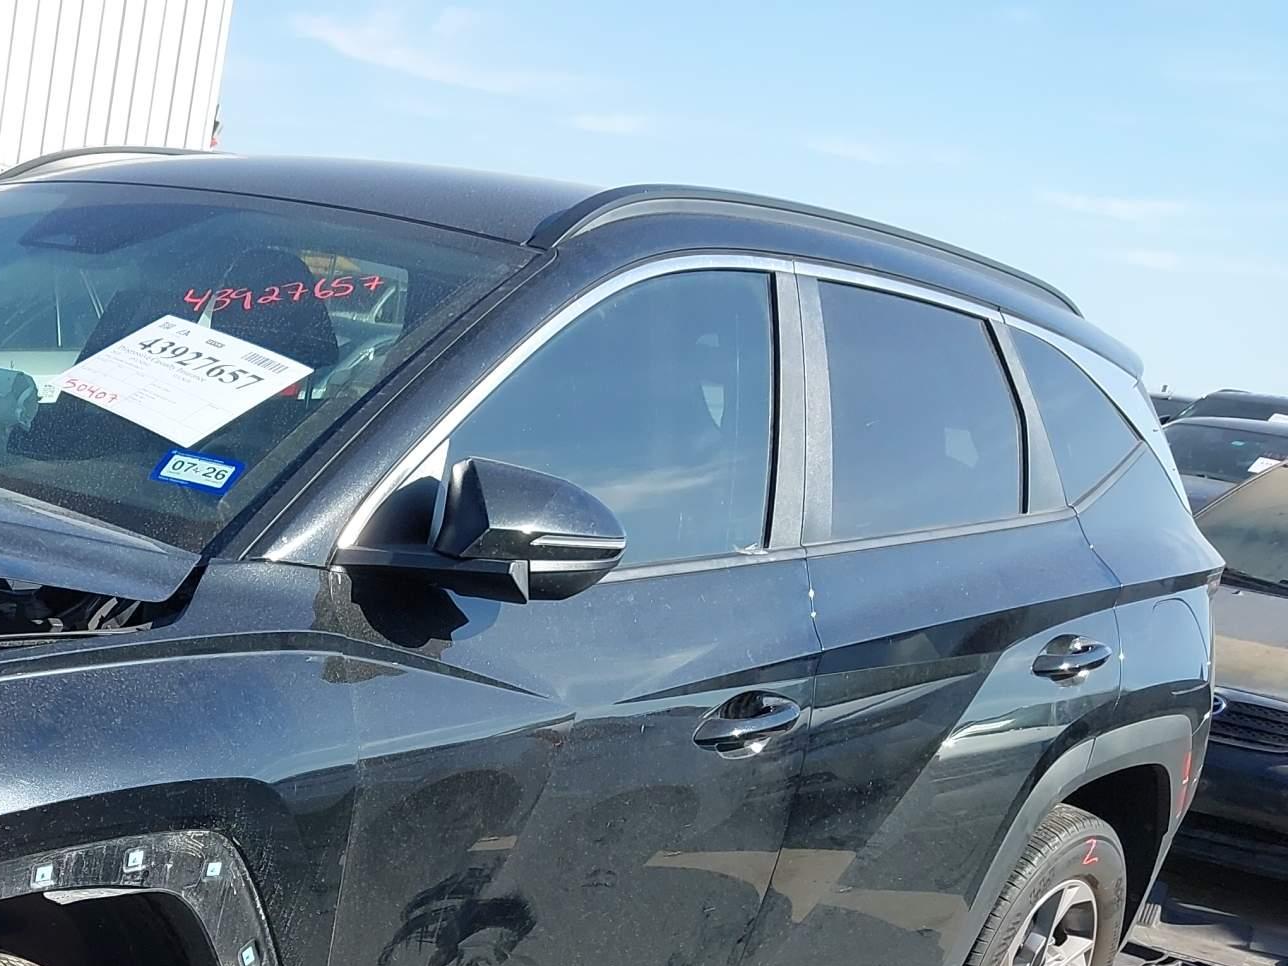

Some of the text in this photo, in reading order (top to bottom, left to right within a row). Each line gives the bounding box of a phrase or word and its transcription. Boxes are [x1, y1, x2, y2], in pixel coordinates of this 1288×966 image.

[183, 275, 385, 312] 43927657
[139, 338, 264, 389] 43927657
[63, 379, 118, 403] 50407
[172, 460, 198, 473] 07
[201, 466, 229, 481] 26
